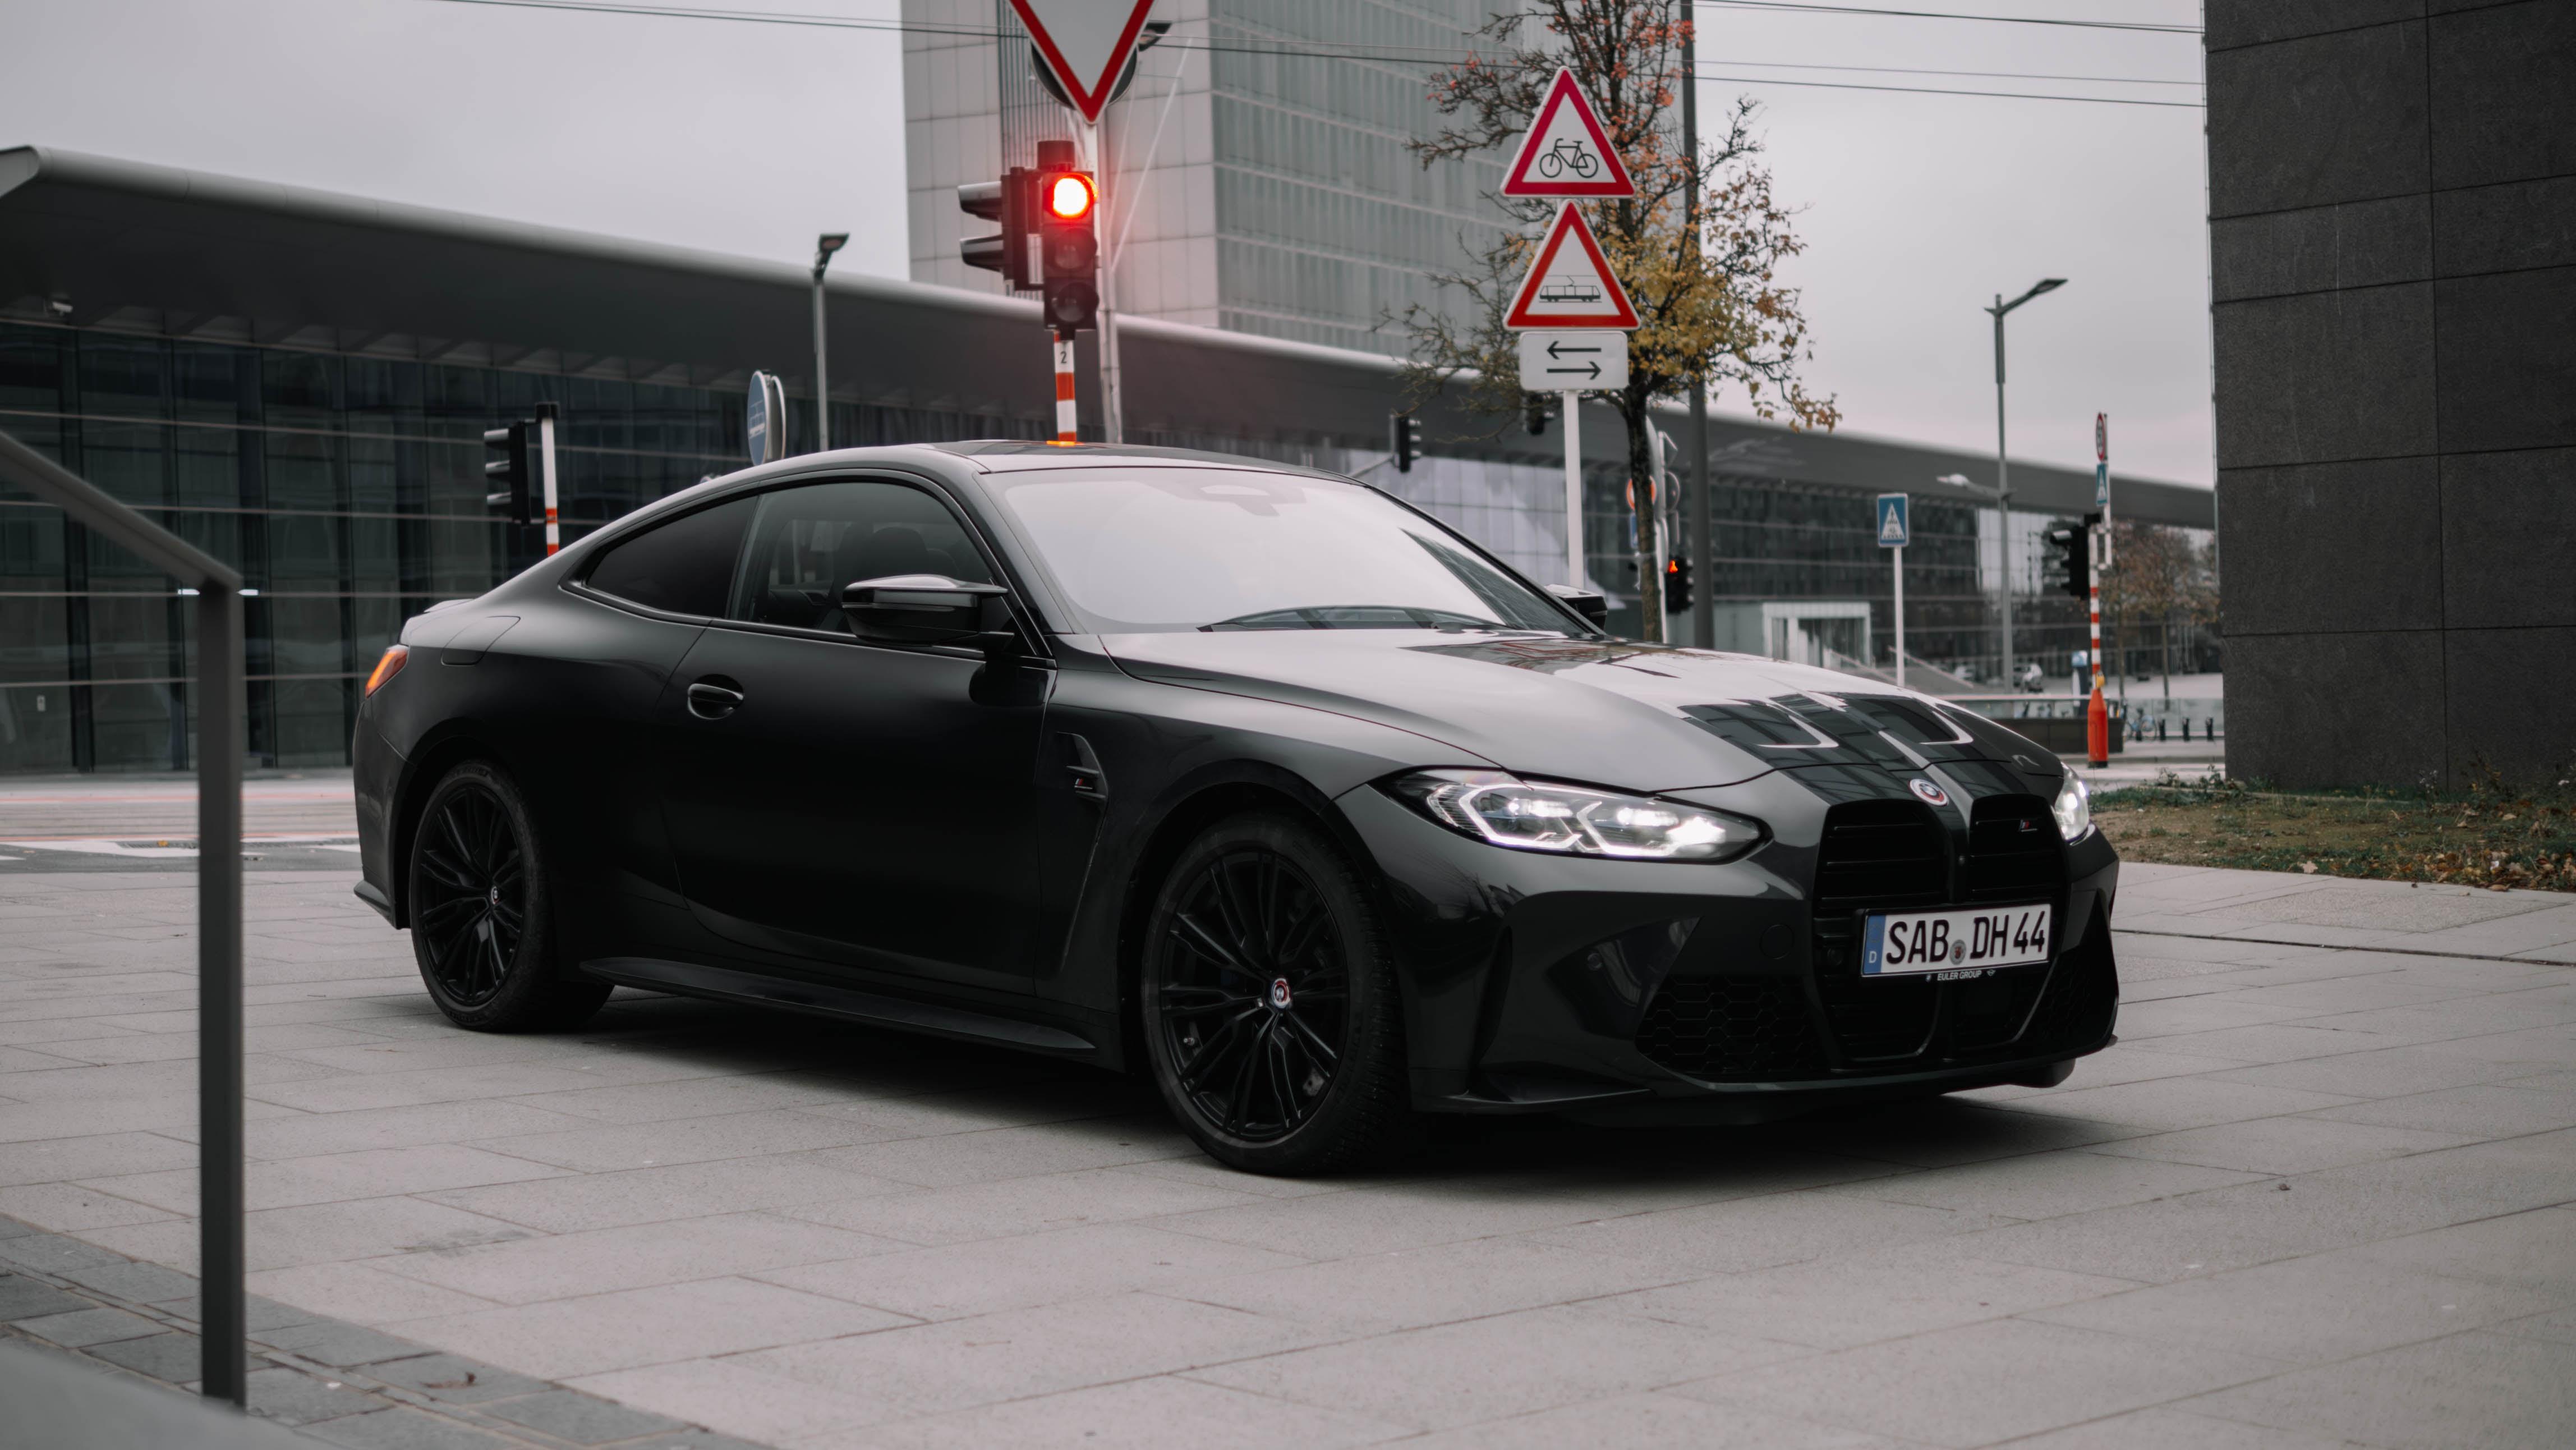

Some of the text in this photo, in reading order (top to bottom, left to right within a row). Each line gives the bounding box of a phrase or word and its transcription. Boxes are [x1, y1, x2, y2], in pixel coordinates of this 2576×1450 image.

[1060, 351, 1067, 364] 2
[1885, 911, 2045, 965] SAB DH 44
[1869, 951, 1876, 963] D
[1937, 970, 1982, 981] EULER GROUP
